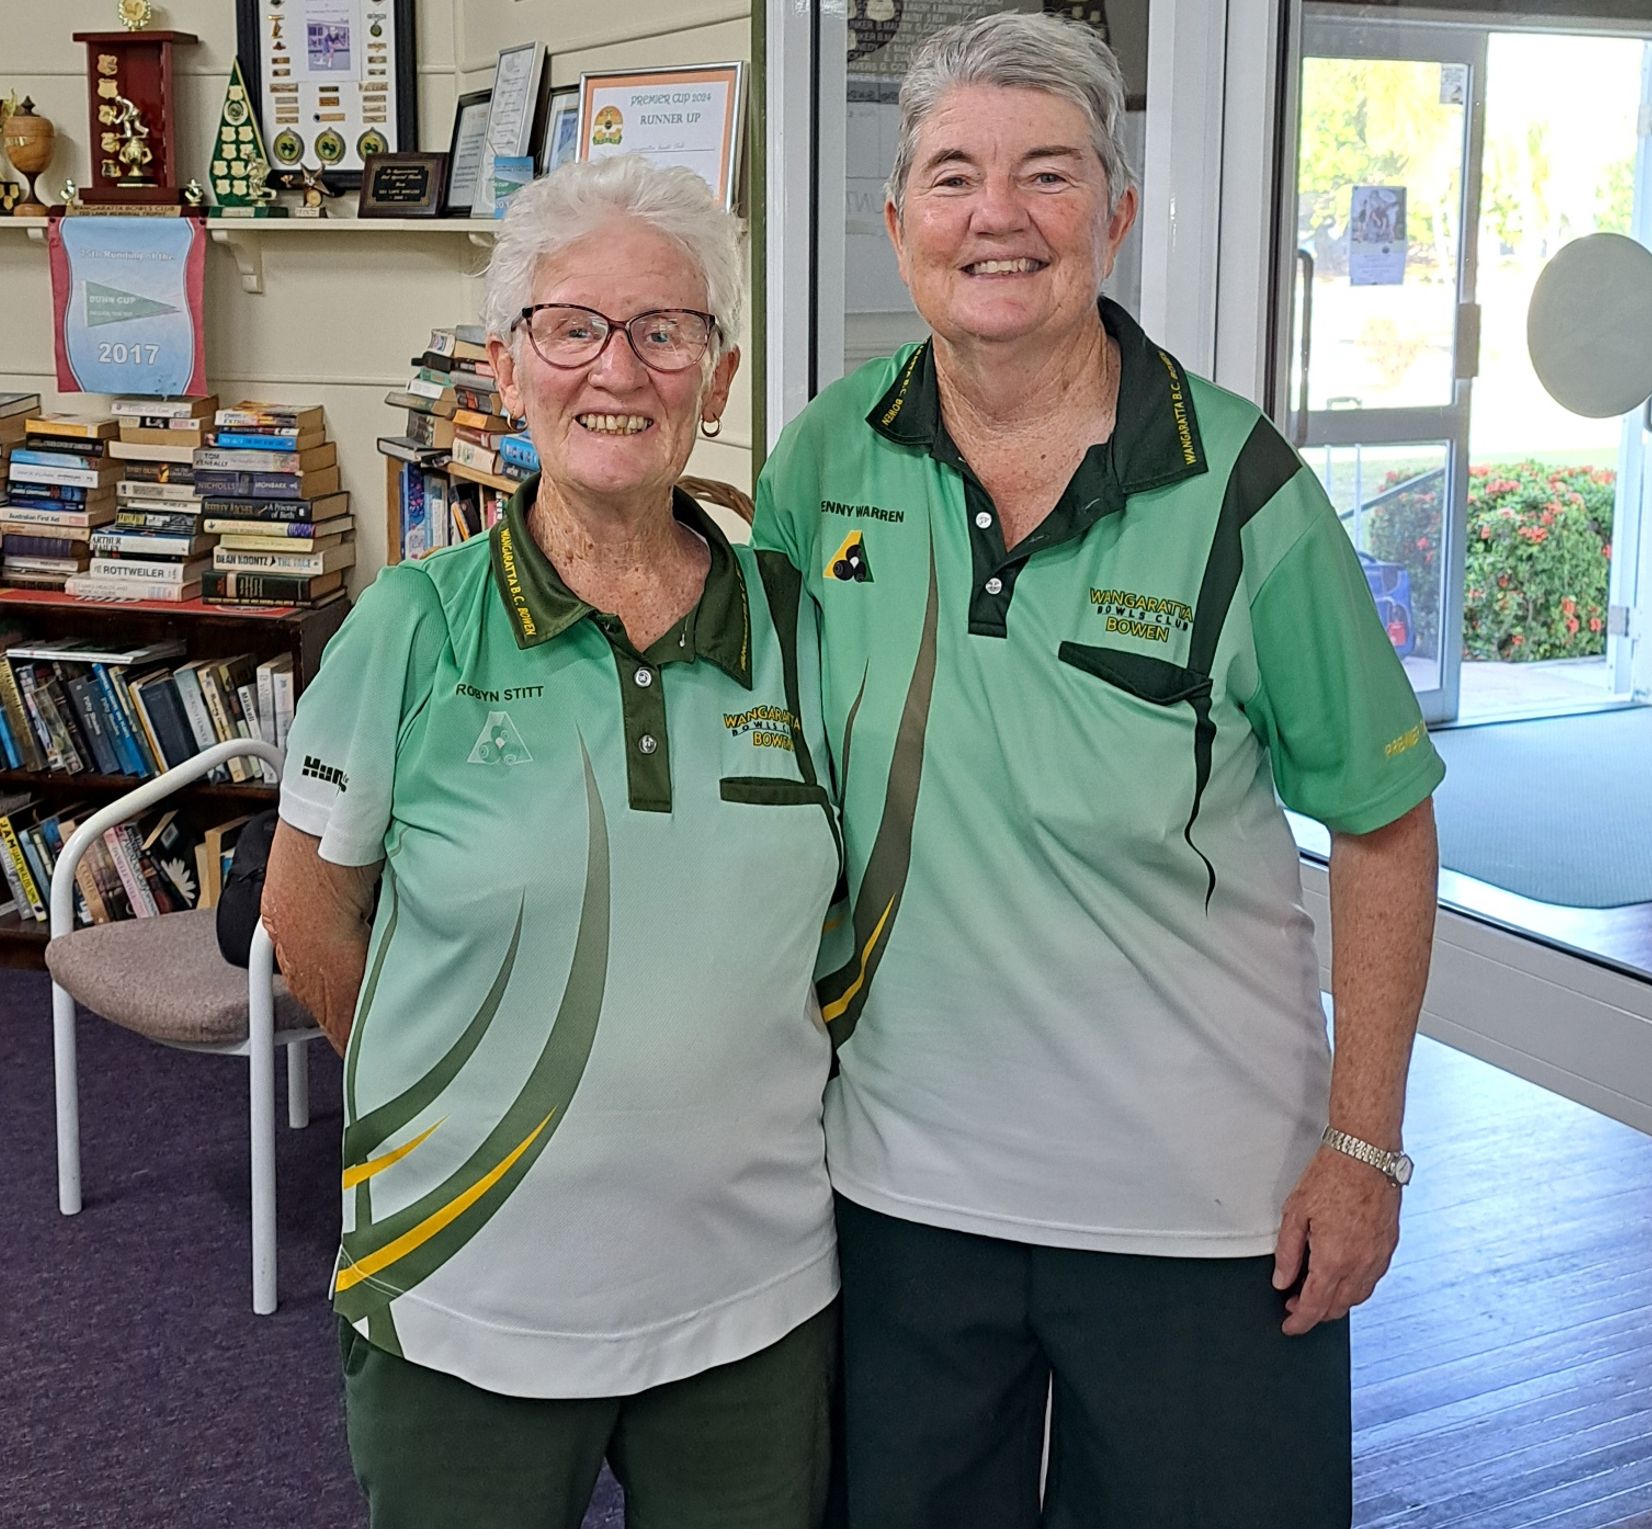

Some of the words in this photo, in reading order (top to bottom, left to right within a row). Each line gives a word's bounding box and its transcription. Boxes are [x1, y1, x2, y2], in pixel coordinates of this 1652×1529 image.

[630, 94, 671, 106] PREMIER
[672, 93, 691, 105] CUP
[692, 92, 712, 103] 2024
[640, 115, 683, 125] RUNNER
[686, 112, 702, 124] UP
[98, 343, 160, 365] 2017
[881, 398, 903, 426] BOWEN
[1174, 401, 1197, 465] WANGARATTA
[204, 452, 220, 460] TOM
[199, 482, 236, 491] NICHOLLS
[820, 500, 855, 517] ENNY
[855, 505, 905, 523] WARREN
[103, 564, 164, 578] ROTTWEILER
[216, 555, 236, 564] DEAN
[238, 555, 268, 566] KOONTZ
[500, 527, 518, 586] WANGARATTA
[517, 607, 536, 637] BOWEN
[1090, 587, 1193, 623] WANGARATTA
[1097, 605, 1146, 621] BOWLS
[1155, 614, 1189, 632] CLUB
[1105, 616, 1170, 643] BOWEN
[455, 683, 500, 702] ROBYN
[503, 685, 545, 701] STITT
[752, 731, 796, 752] BOWE
[0, 822, 16, 849] JAM
